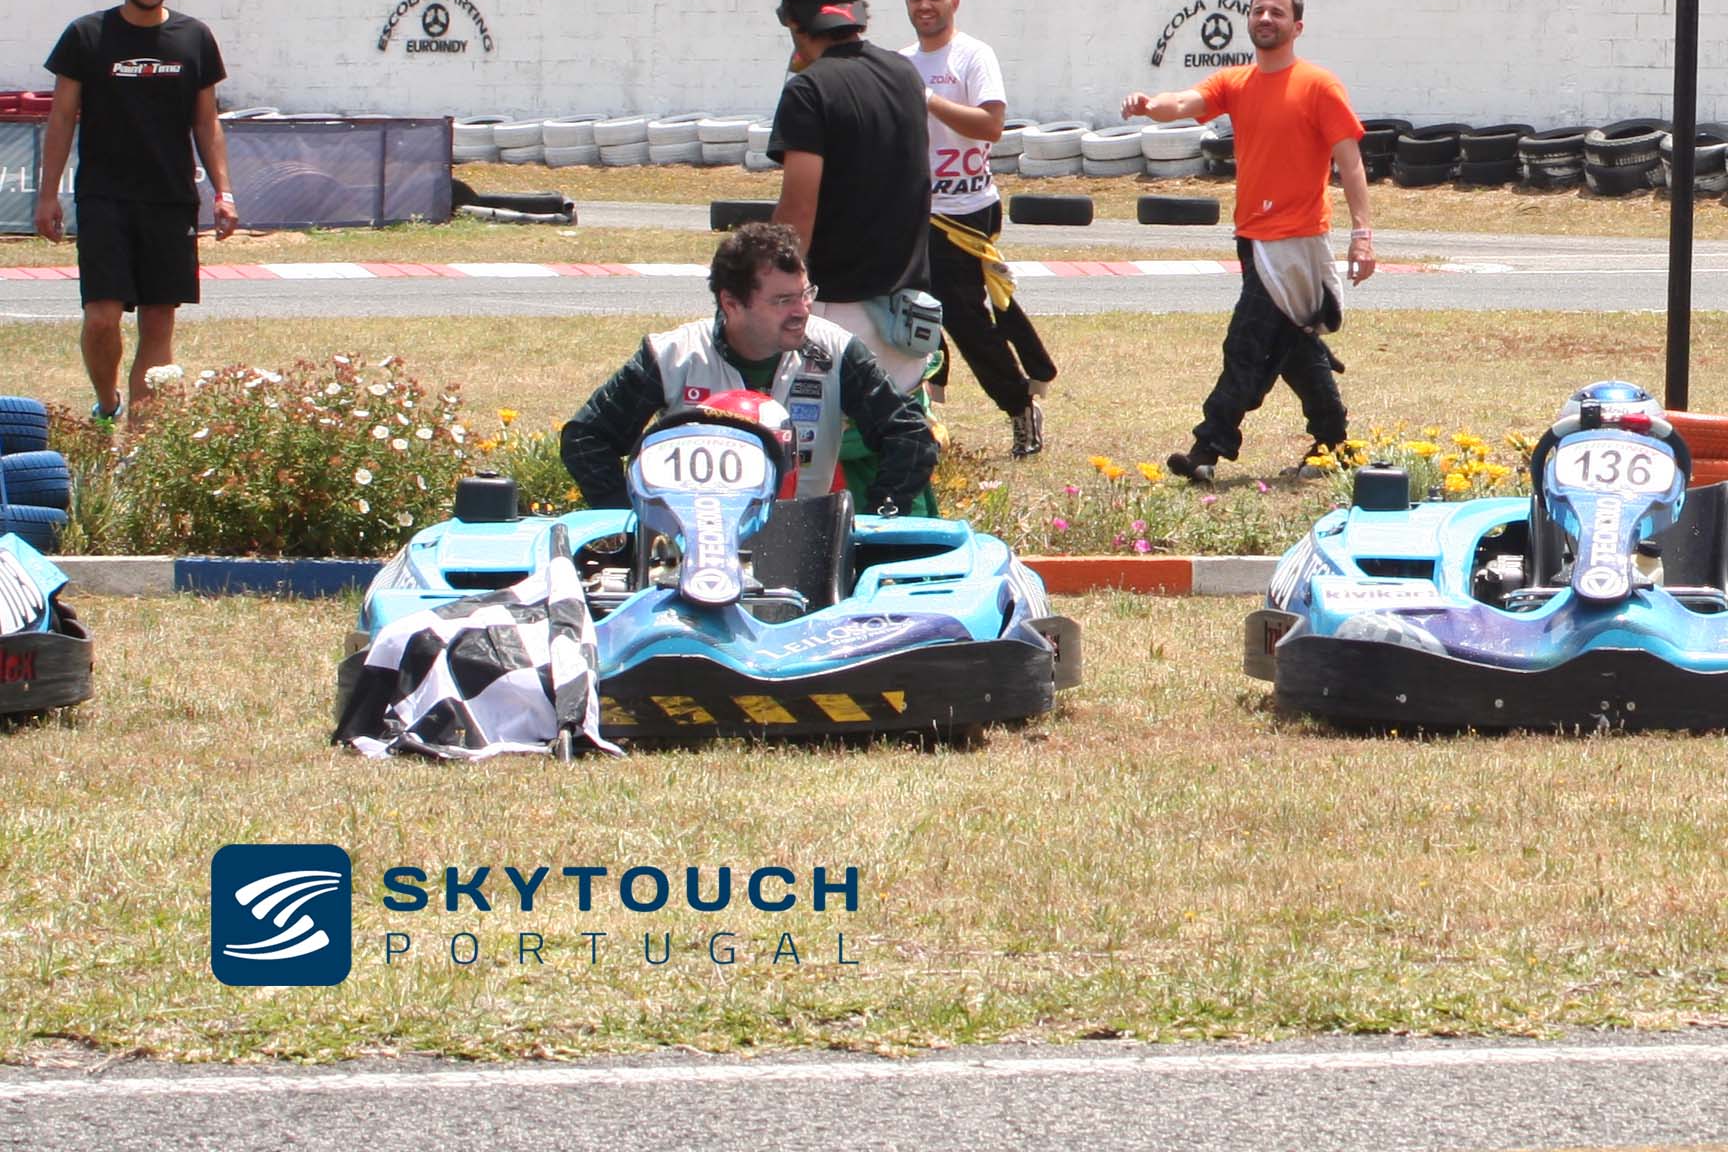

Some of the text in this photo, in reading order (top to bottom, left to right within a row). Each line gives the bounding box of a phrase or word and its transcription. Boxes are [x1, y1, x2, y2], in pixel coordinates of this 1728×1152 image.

[406, 39, 469, 53] EUROINDY
[1151, 0, 1207, 67] ESCOLA
[1184, 52, 1254, 67] EUROINDY
[664, 447, 742, 483] 100
[1574, 449, 1652, 485] 136
